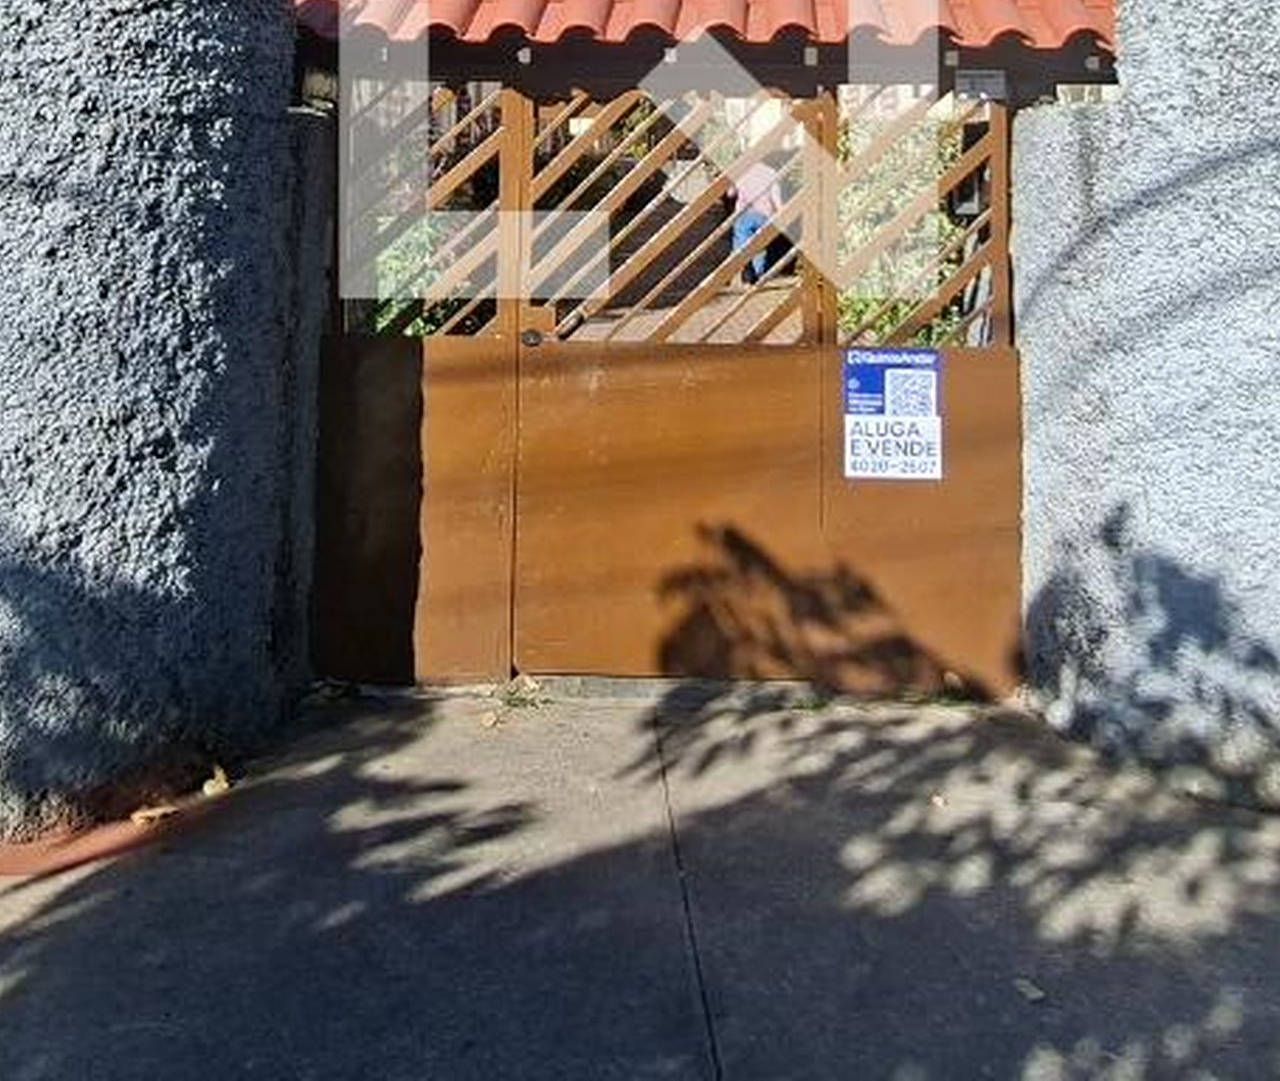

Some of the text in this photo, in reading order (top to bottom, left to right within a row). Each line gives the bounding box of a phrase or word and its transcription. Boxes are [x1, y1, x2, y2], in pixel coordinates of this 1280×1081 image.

[850, 421, 921, 437] ALUGA
[851, 439, 937, 457] E VENDE
